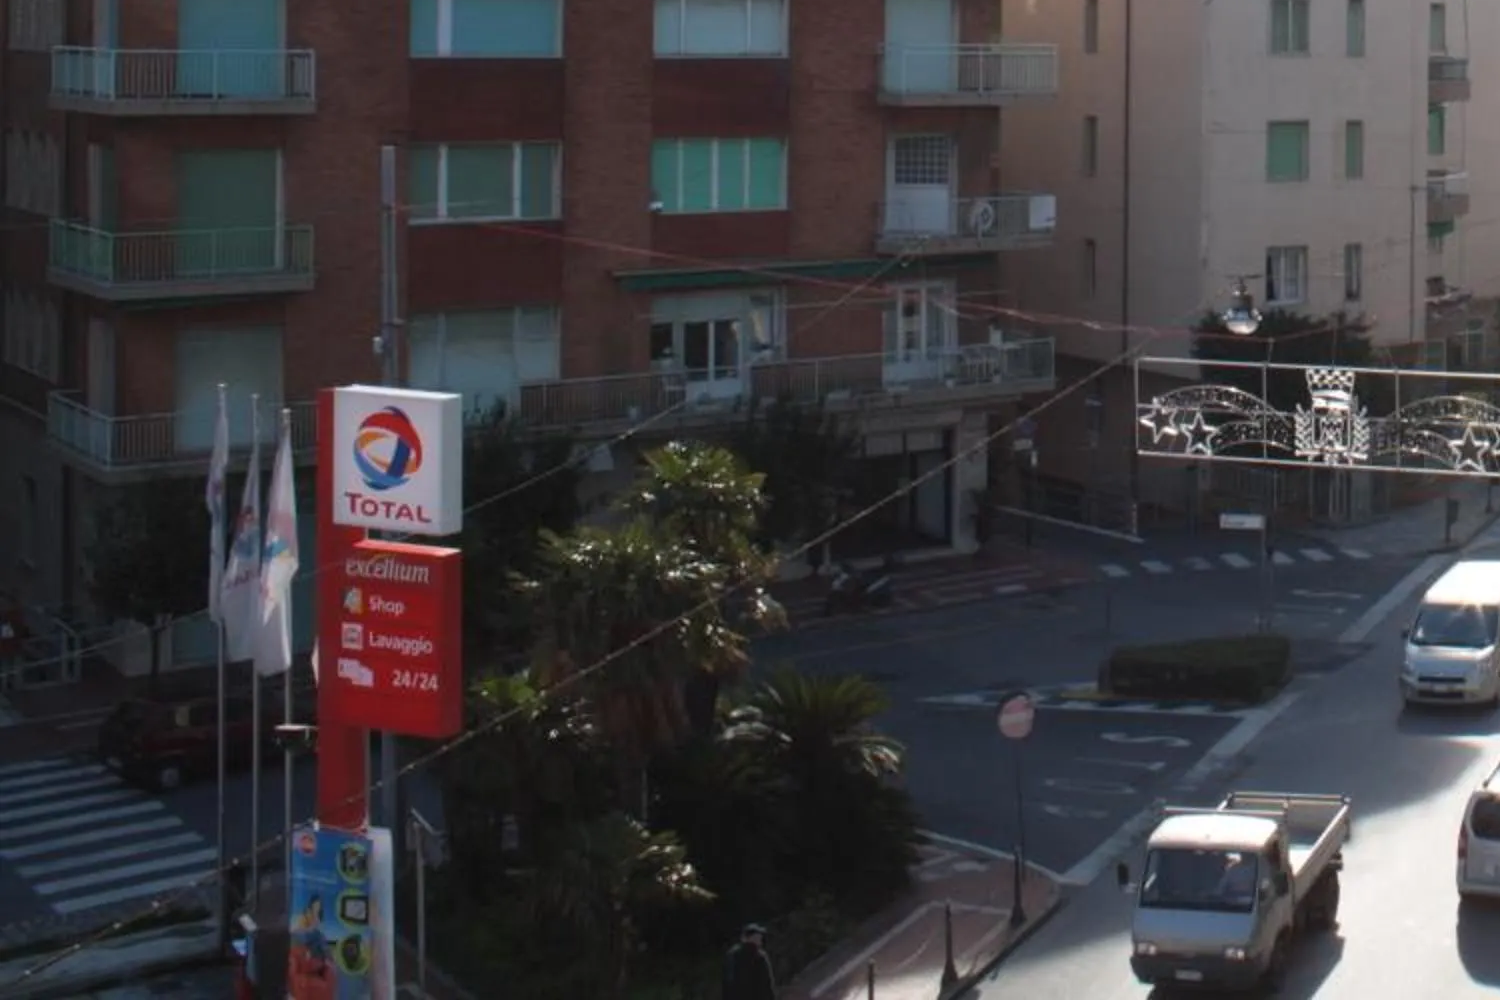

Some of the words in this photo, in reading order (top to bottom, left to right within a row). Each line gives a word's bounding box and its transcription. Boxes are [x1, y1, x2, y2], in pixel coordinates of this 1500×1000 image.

[345, 492, 432, 524] TOTAL
[346, 557, 430, 585] excellium
[369, 596, 405, 616] Shop
[369, 631, 432, 657] Lavaggio
[391, 670, 440, 692] 24/24
